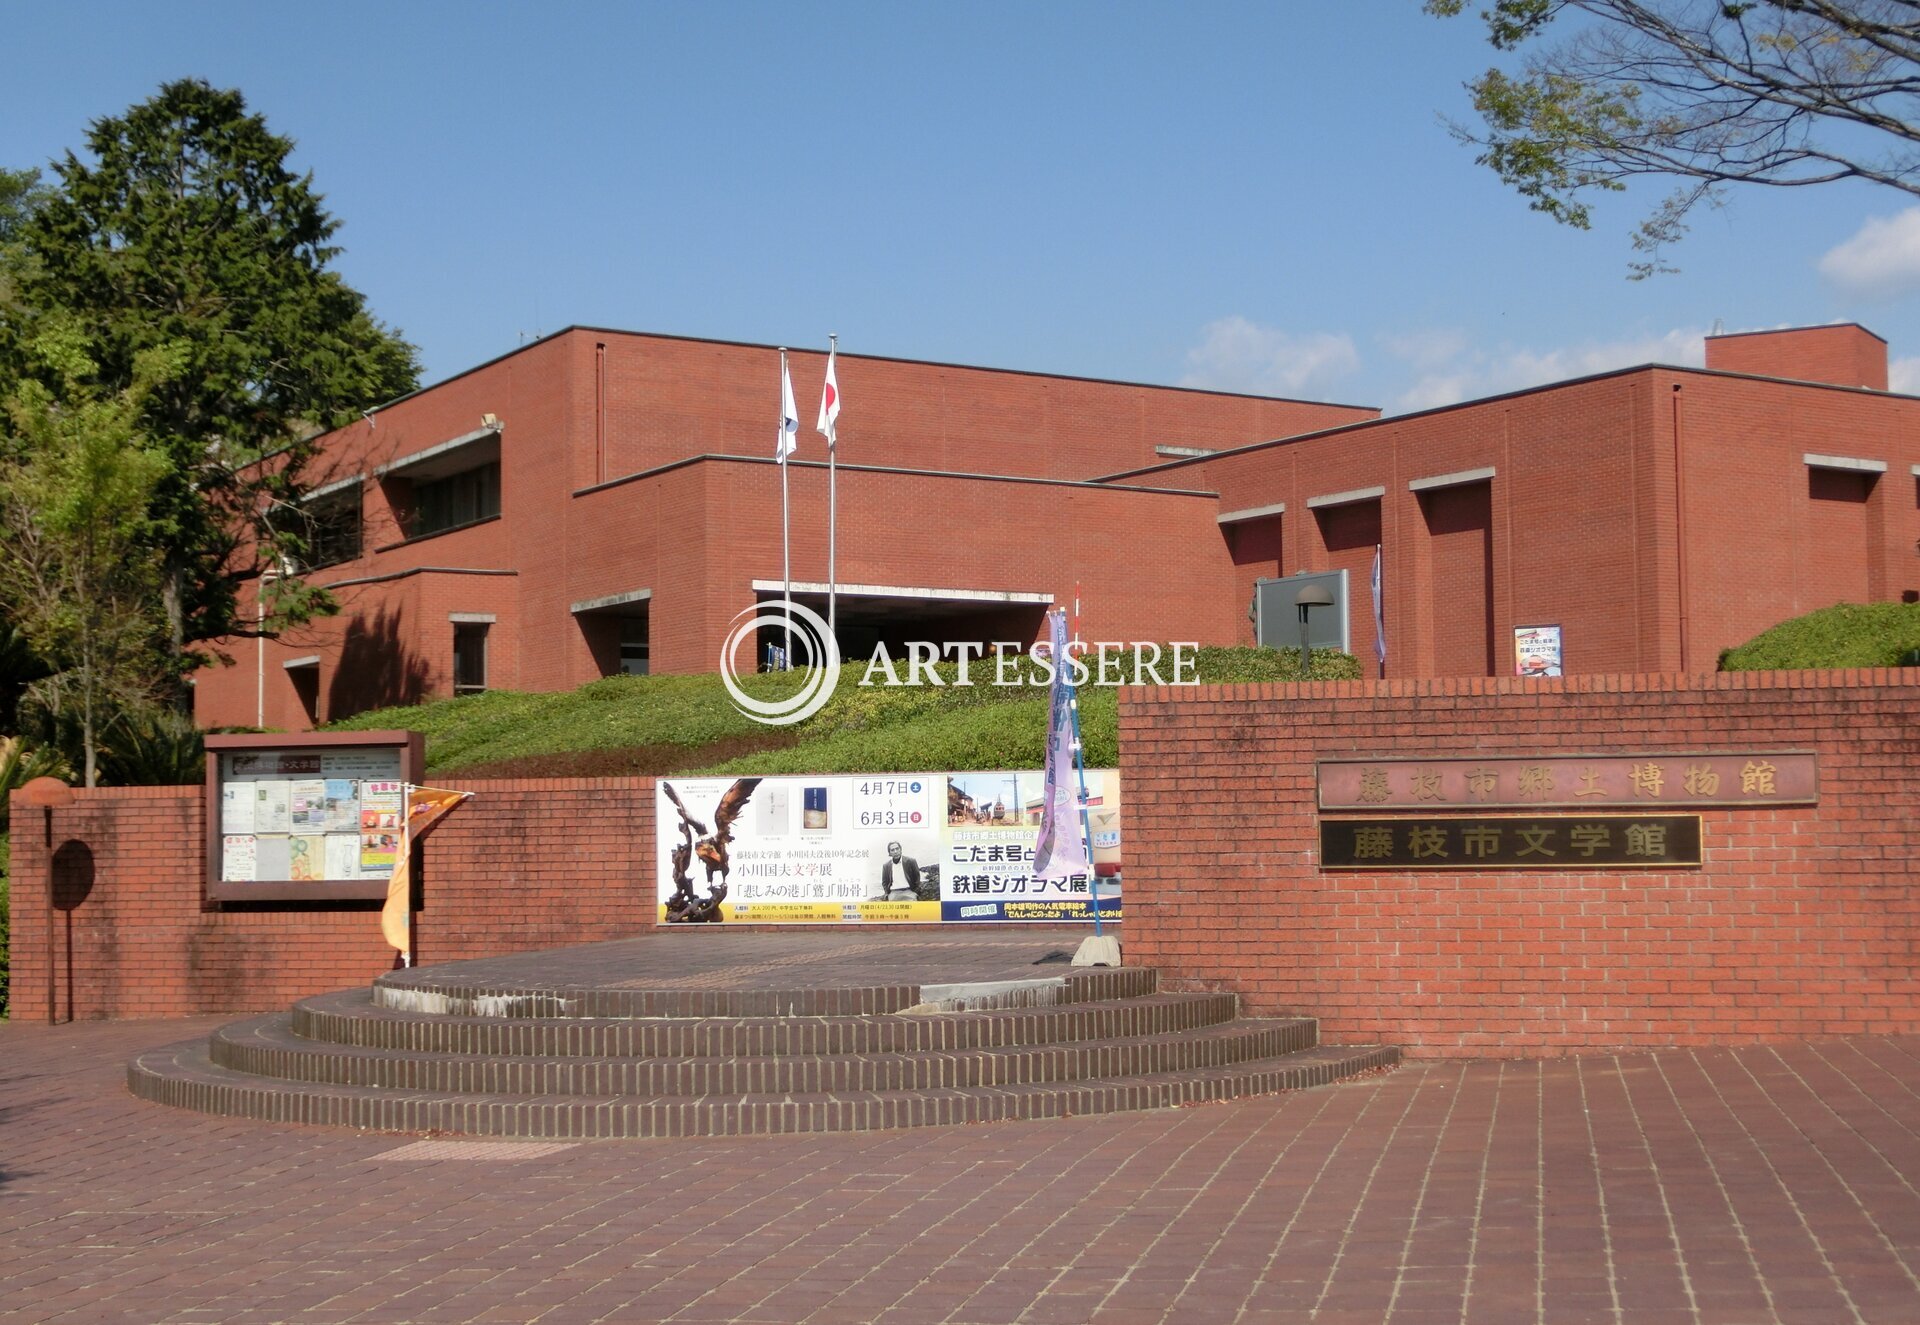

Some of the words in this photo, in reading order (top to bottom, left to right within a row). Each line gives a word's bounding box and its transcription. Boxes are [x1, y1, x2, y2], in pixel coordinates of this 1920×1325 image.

[1357, 760, 1778, 803] 藤枝市郷土博物館
[1353, 823, 1667, 858] 藤枝市文学館
[736, 850, 781, 860] 藤枝市文学館
[738, 863, 832, 877] 小川国夫文学展
[952, 874, 1087, 893] 鉄道ジオラマ展
